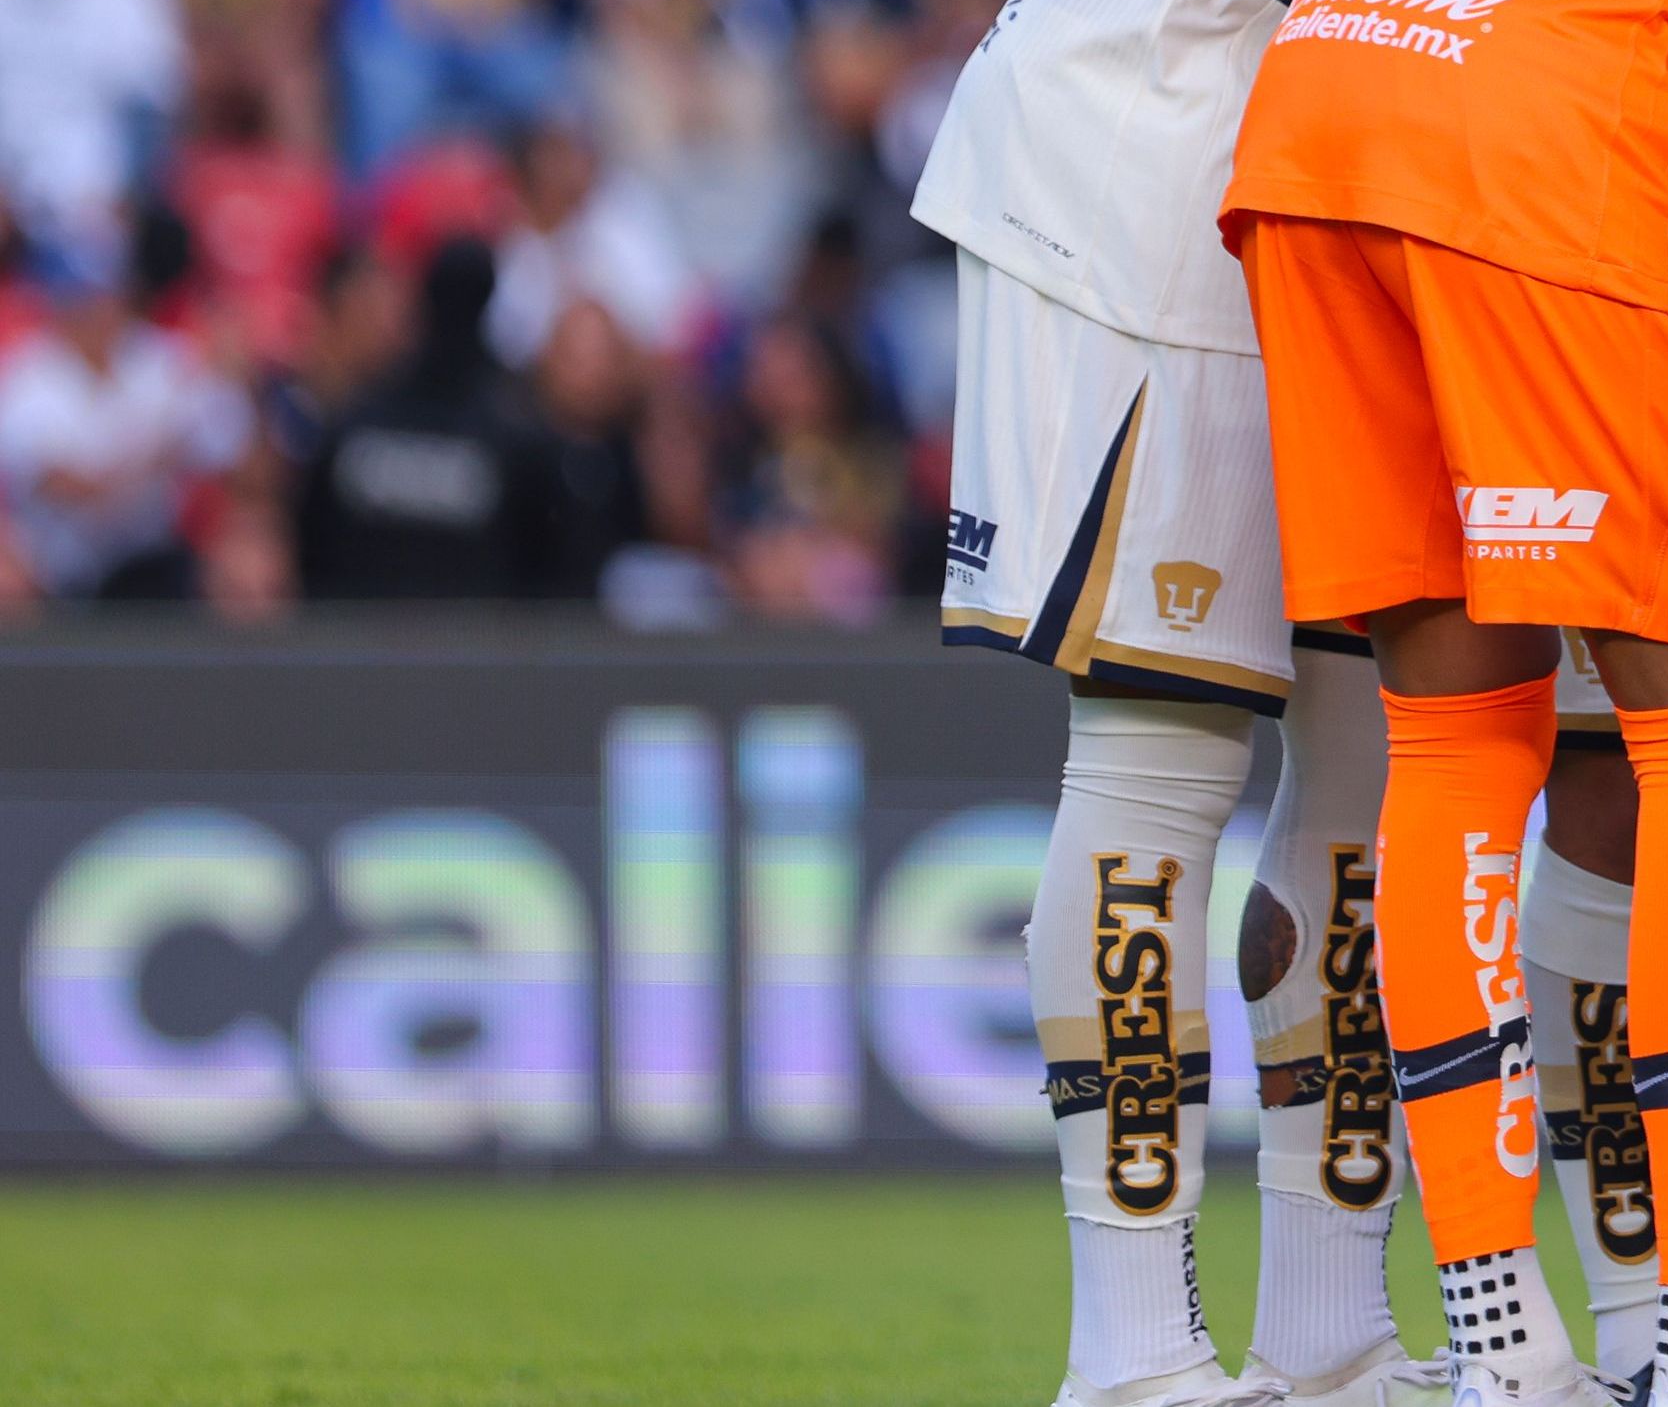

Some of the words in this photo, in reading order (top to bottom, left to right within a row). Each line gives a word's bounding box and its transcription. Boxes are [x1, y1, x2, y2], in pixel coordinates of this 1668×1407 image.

[1092, 851, 1184, 1217] CREST
[1463, 830, 1540, 1180] CREST
[1571, 978, 1658, 1266] CRES
